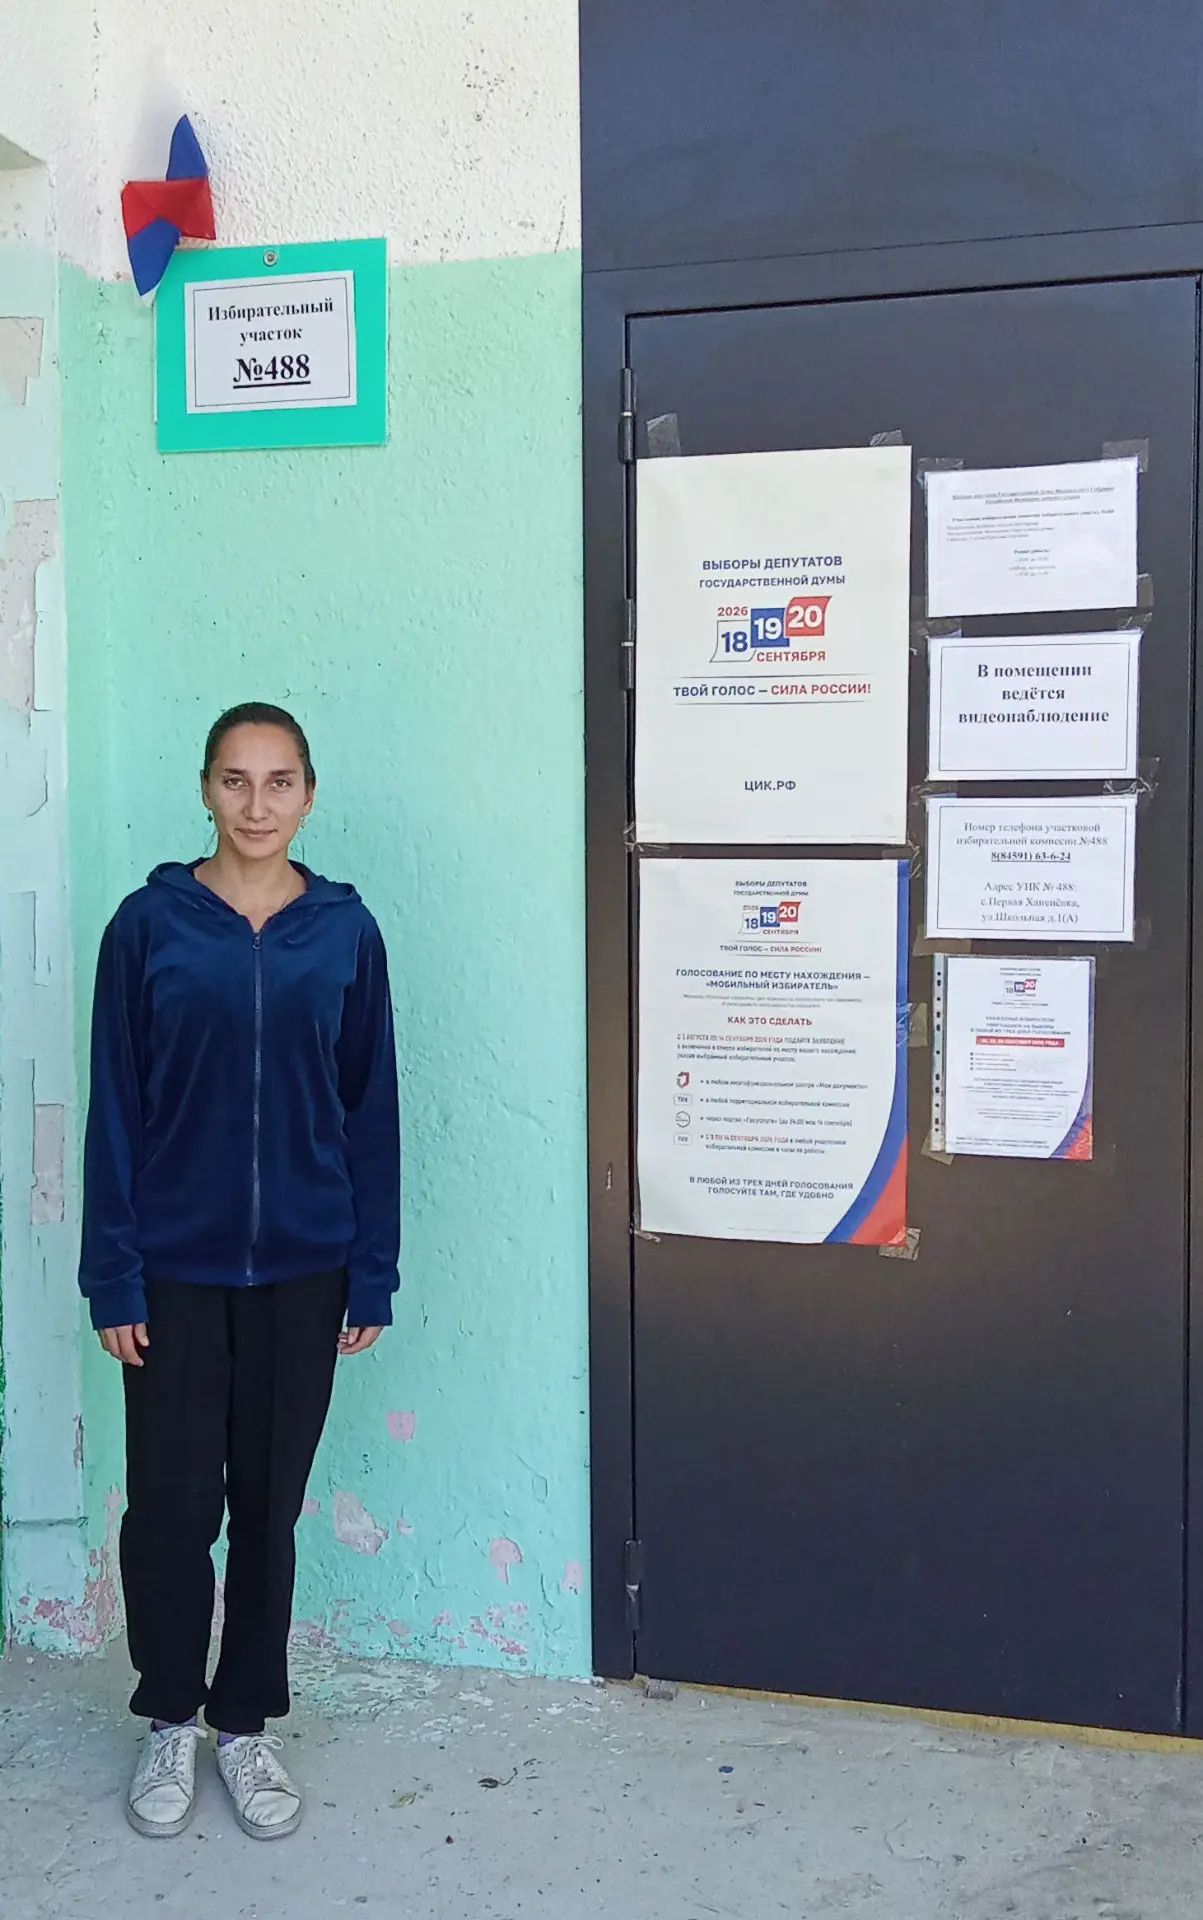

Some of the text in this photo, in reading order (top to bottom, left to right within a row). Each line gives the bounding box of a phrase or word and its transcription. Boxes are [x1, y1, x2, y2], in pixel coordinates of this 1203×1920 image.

[208, 298, 333, 321] Избирательный
[240, 327, 302, 346] участок
[233, 353, 310, 384] №488
[702, 556, 843, 571] ВЫБОРЫ ДЕПУТАТОВ
[700, 575, 846, 589] ГОСУДАРСТВЕННОЙ ДУМЫ
[717, 606, 749, 617] 2026
[721, 605, 823, 653] 18 19 20
[756, 651, 826, 663] СЕНТЯБРЯ
[977, 664, 1092, 678] В помещении
[673, 685, 708, 697] ТВОЙ
[712, 685, 756, 697] ГОЛОС
[770, 684, 808, 696] СИЛА
[811, 683, 872, 695] РОССИИ!
[1002, 687, 1065, 701] ведётся
[958, 709, 1110, 724] видеонаблюдение
[744, 780, 796, 792] ЦИК.РФ
[964, 822, 996, 834] Номер
[998, 822, 1043, 834] телефона
[991, 851, 1071, 862] 8(84591) 63-6-24
[984, 882, 1013, 893] Адрес
[744, 906, 797, 929] 18 19 20
[676, 969, 743, 978] ГОЛОСОВАНИЕ
[745, 970, 759, 978] ПО
[760, 971, 791, 979] МЕСТУ
[793, 971, 862, 980] НАХОЖДЕНИЯ
[728, 1016, 813, 1026] КАК ЭТО СДЕЛАТЬ
[697, 1176, 727, 1185] ЛЮБОЙ
[765, 1179, 788, 1188] ДНЕЙ
[789, 1181, 853, 1190] ГОЛОСОВАНИЯ
[708, 1187, 757, 1196] ГОЛОСУЙТЕ
[781, 1190, 796, 1198] ГДЕ
[799, 1191, 834, 1199] УДОБНО
